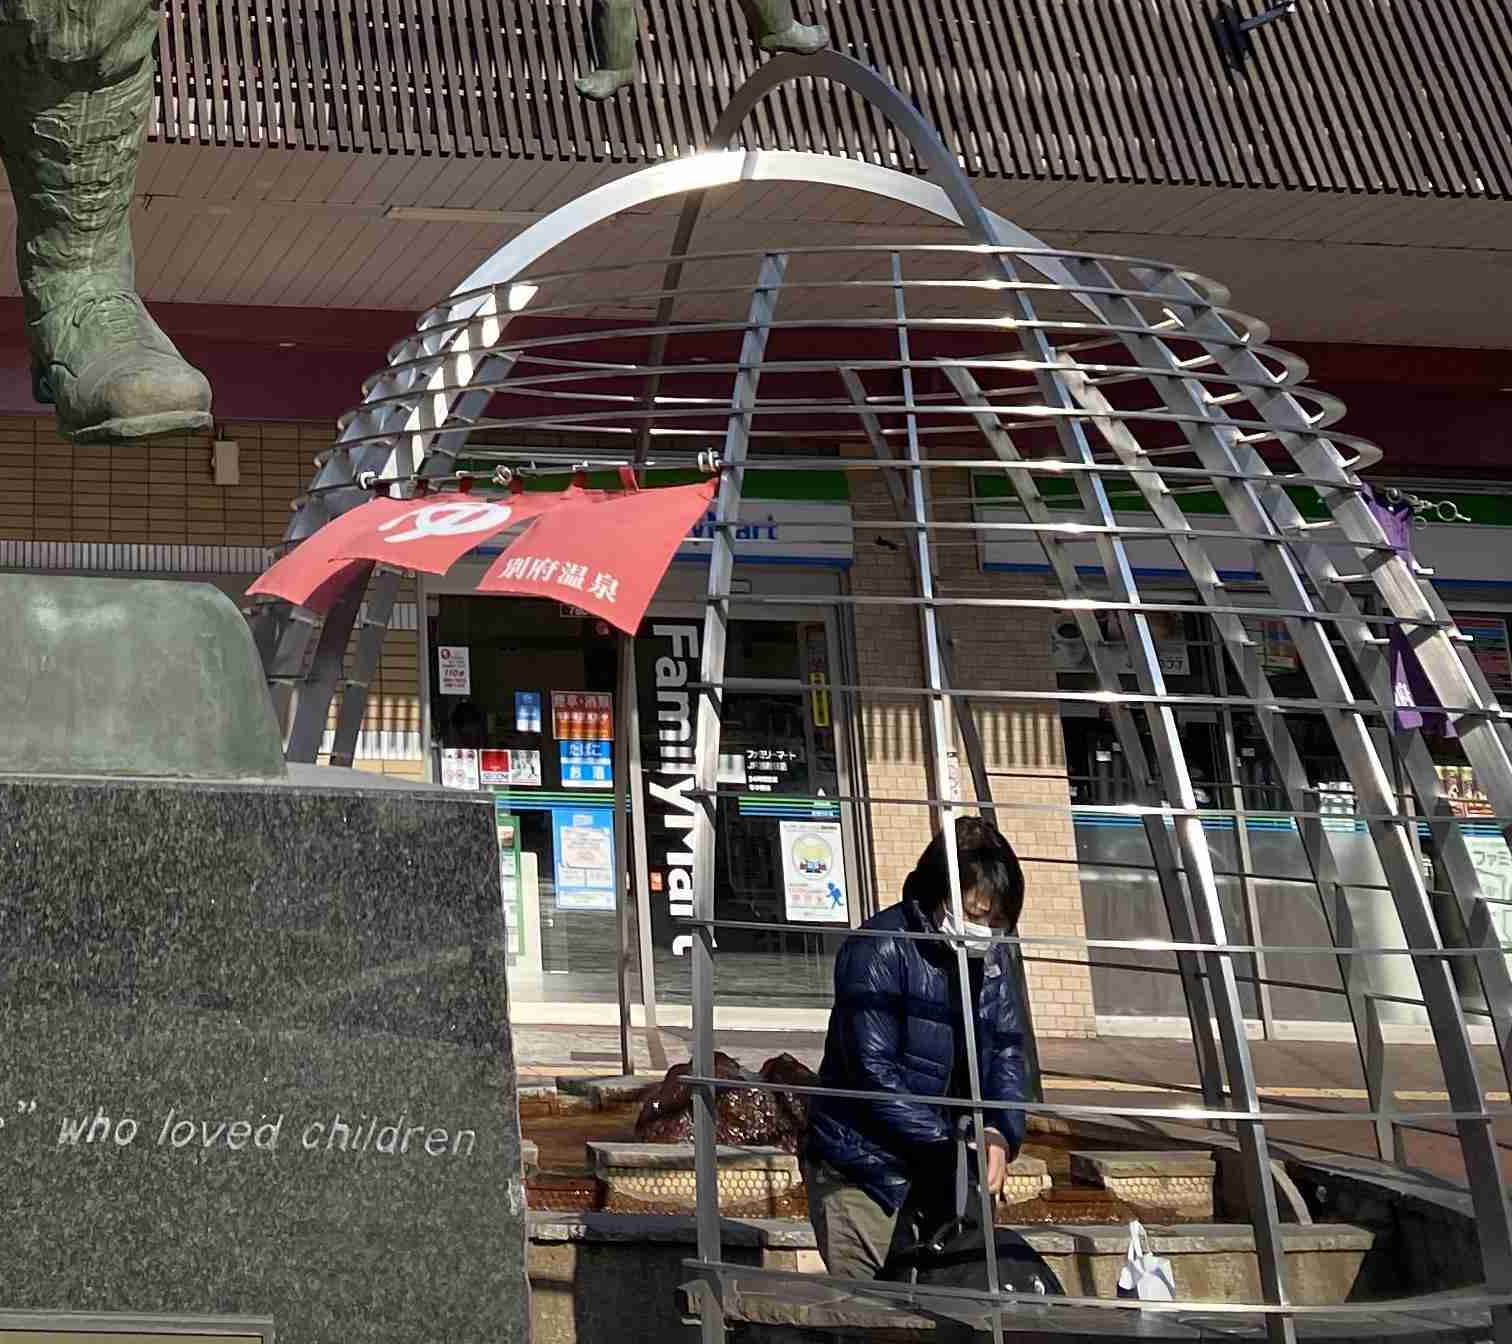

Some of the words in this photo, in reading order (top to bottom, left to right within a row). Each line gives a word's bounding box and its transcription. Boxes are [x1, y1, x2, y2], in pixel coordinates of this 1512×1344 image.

[498, 557, 619, 604] 別府温泉
[56, 1107, 139, 1146] who
[157, 1107, 285, 1150] loved
[301, 1109, 478, 1157] children
